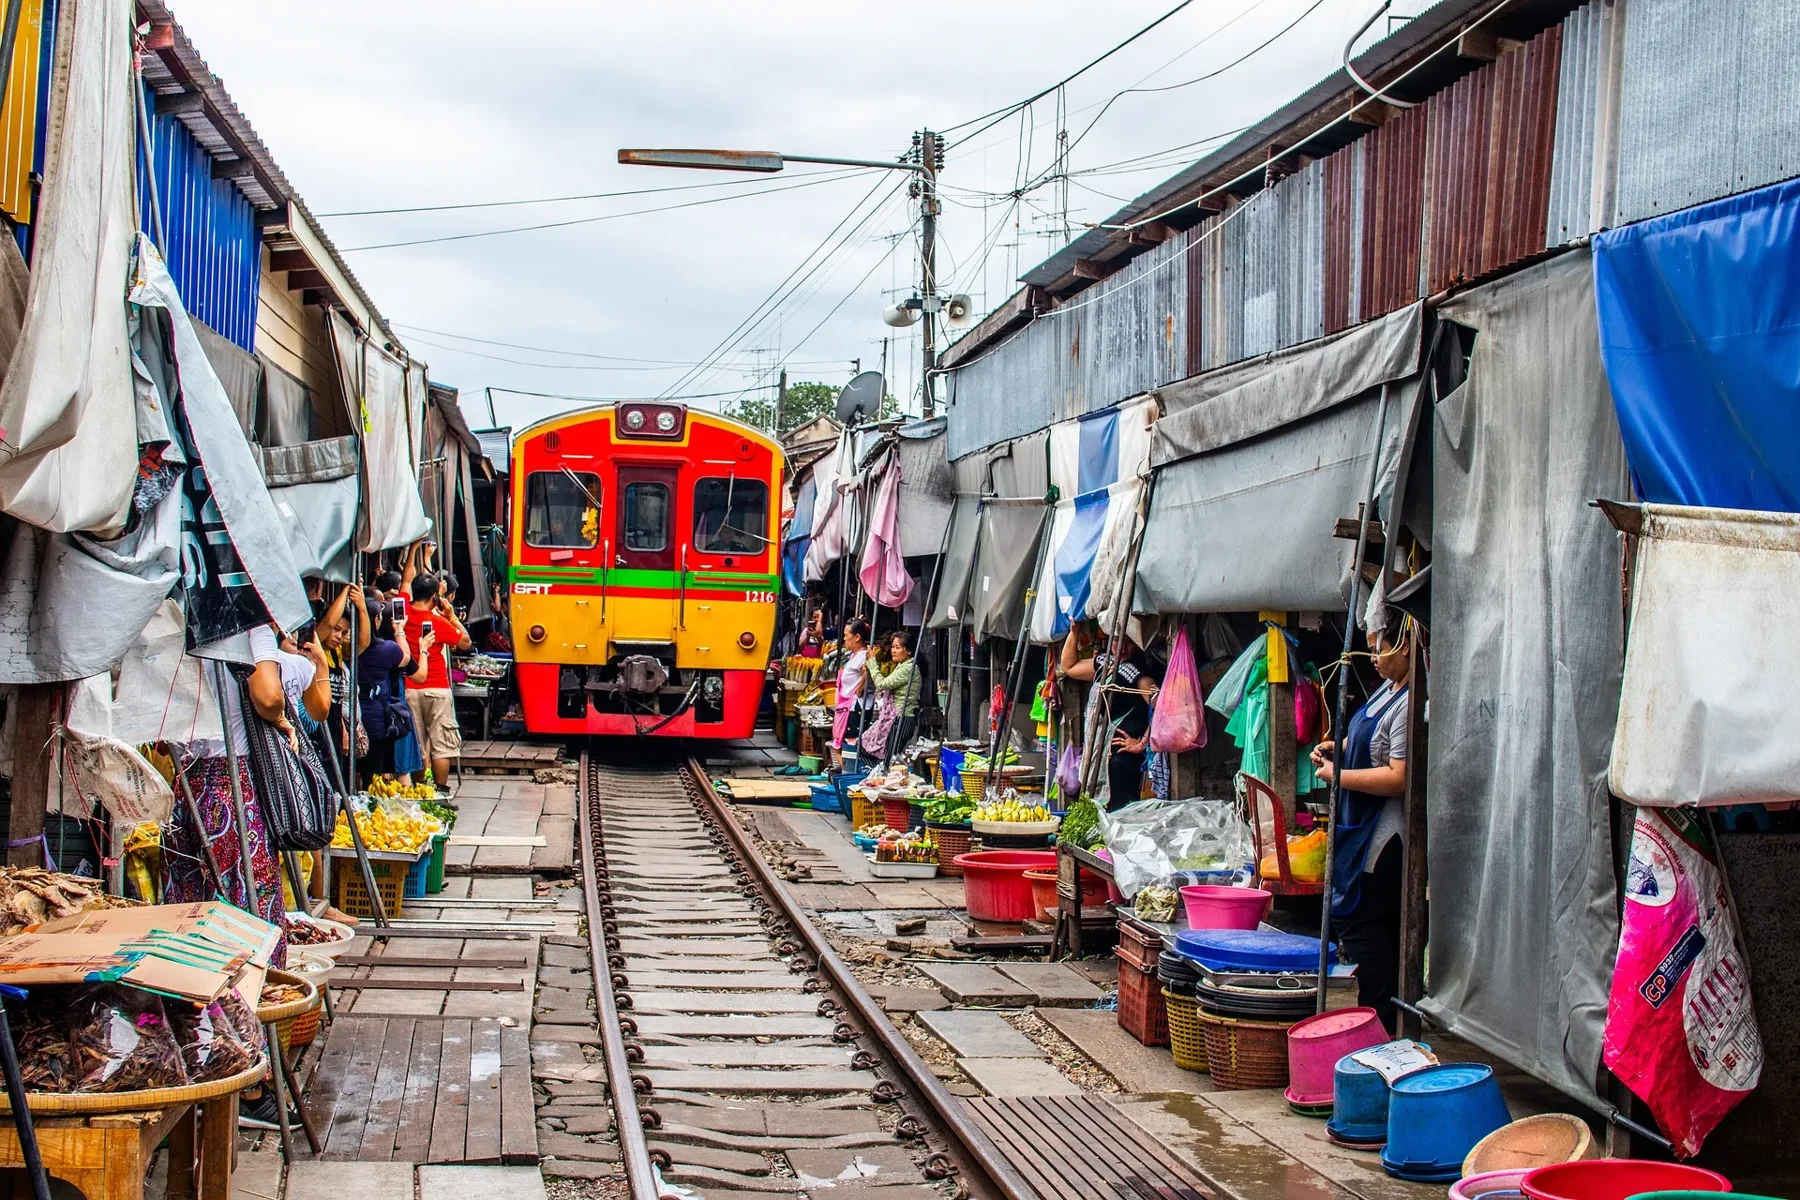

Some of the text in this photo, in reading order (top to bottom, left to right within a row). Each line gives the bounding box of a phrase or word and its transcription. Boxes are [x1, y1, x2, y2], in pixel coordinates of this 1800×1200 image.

[514, 582, 553, 595] SRT
[745, 590, 774, 604] 1216
[1645, 974, 1667, 1002] CP
